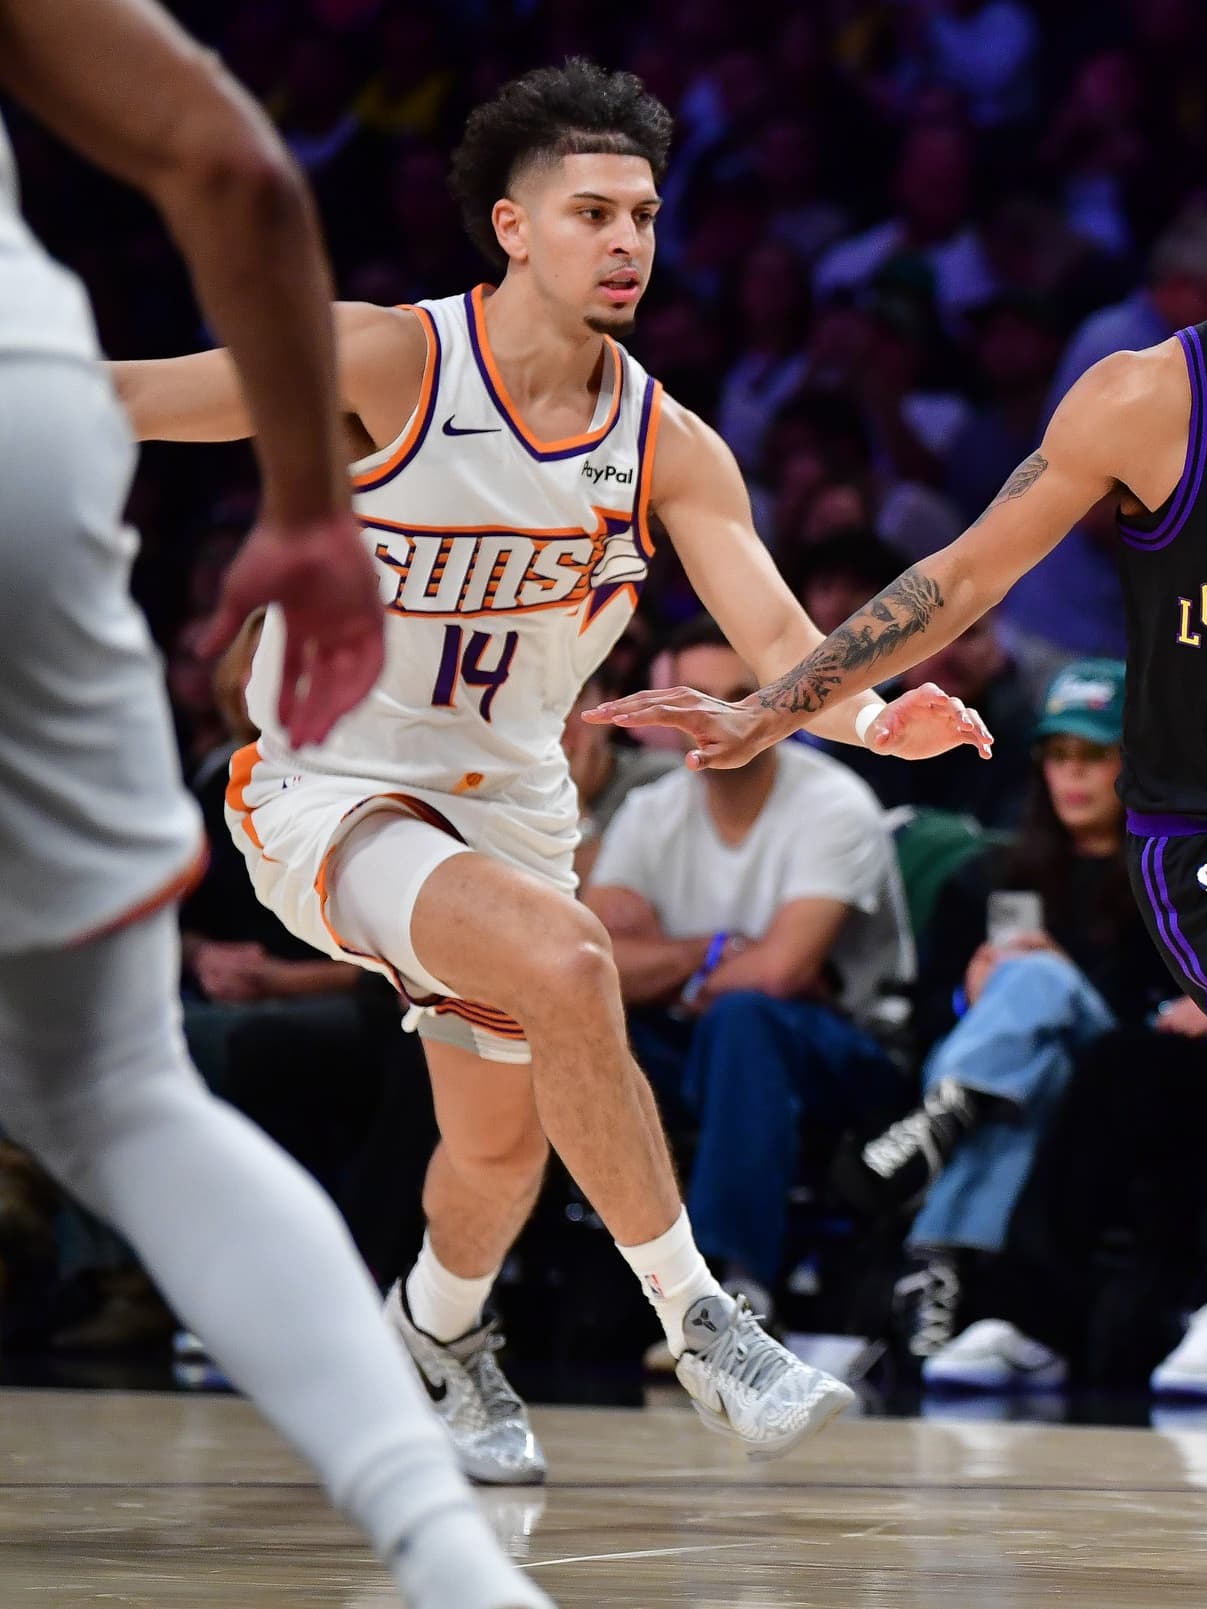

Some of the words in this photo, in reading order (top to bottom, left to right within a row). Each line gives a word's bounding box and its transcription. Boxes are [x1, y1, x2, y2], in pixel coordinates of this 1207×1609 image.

[581, 460, 634, 485] PayPal
[359, 526, 595, 612] SUNS
[431, 624, 519, 723] 14
